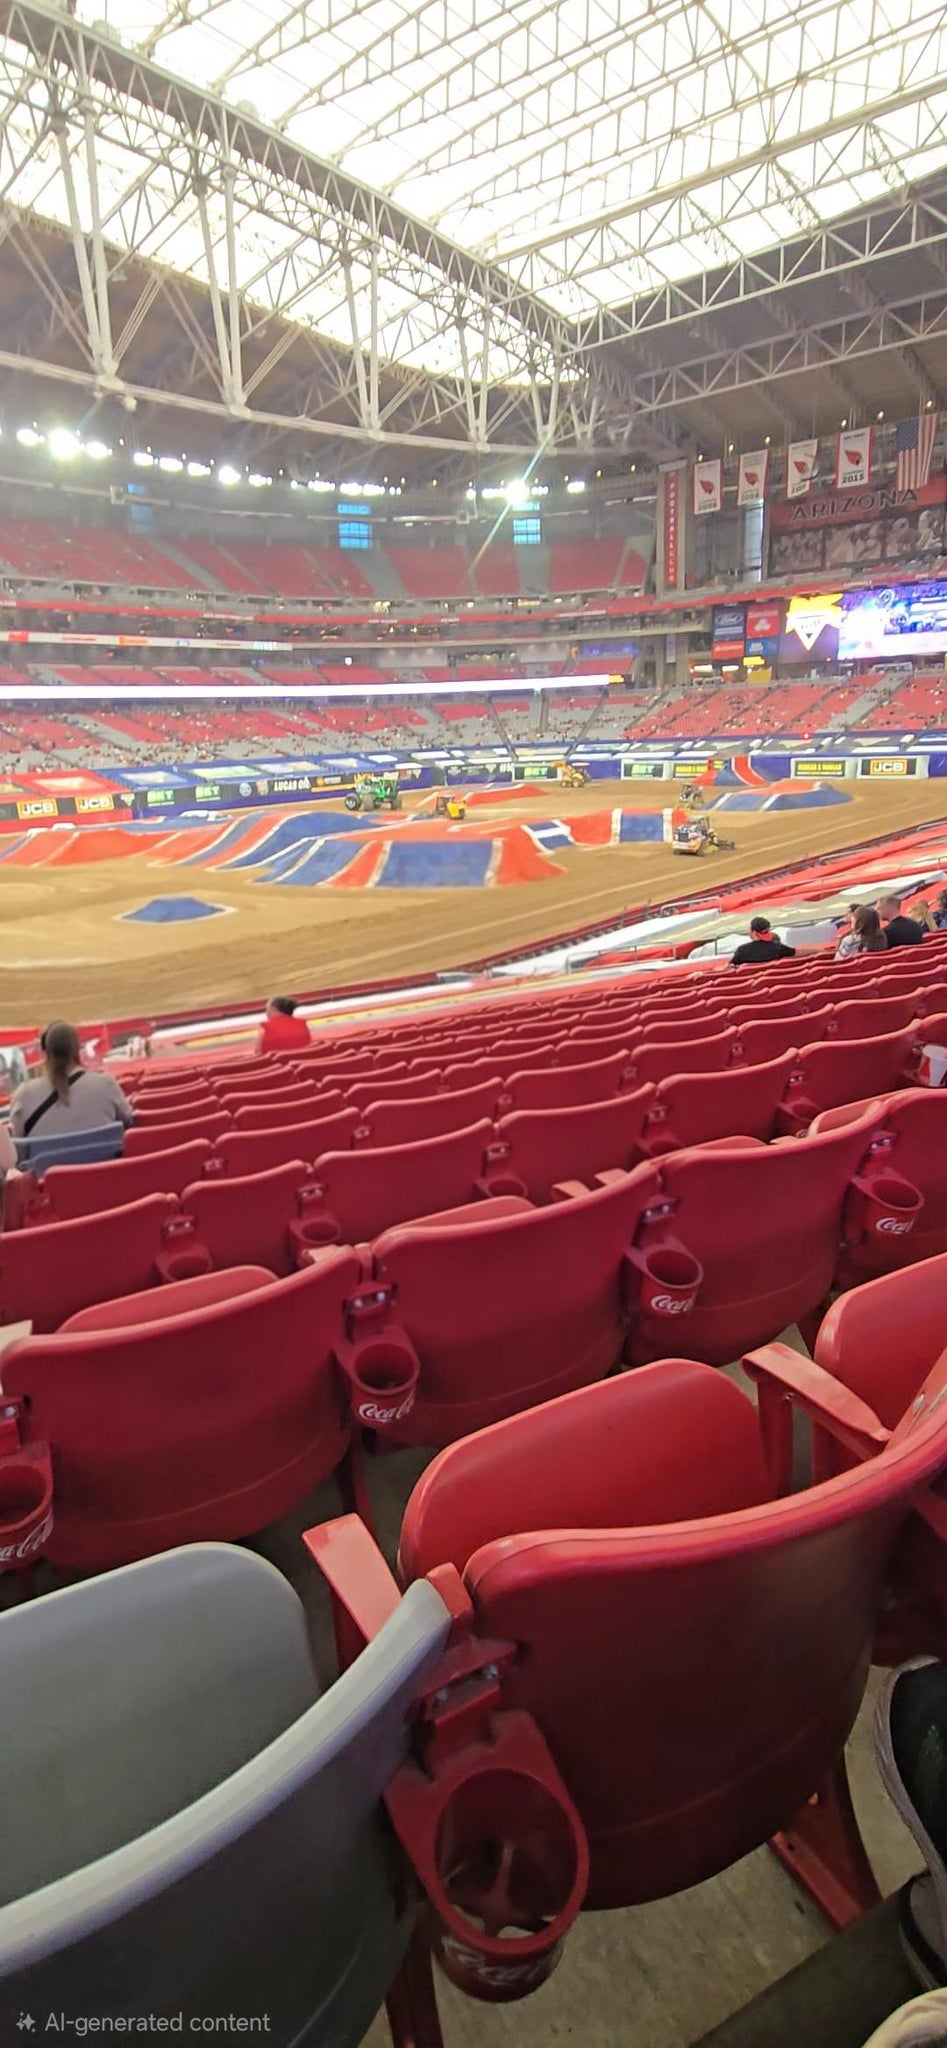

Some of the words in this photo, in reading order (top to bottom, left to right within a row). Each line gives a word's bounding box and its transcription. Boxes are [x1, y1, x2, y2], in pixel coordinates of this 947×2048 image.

[841, 473, 865, 484] 2015
[791, 488, 918, 521] ARIZONA
[873, 761, 905, 773] JCB
[274, 780, 298, 792] LUCAS
[21, 802, 54, 817] JCB
[79, 797, 111, 810] JCB
